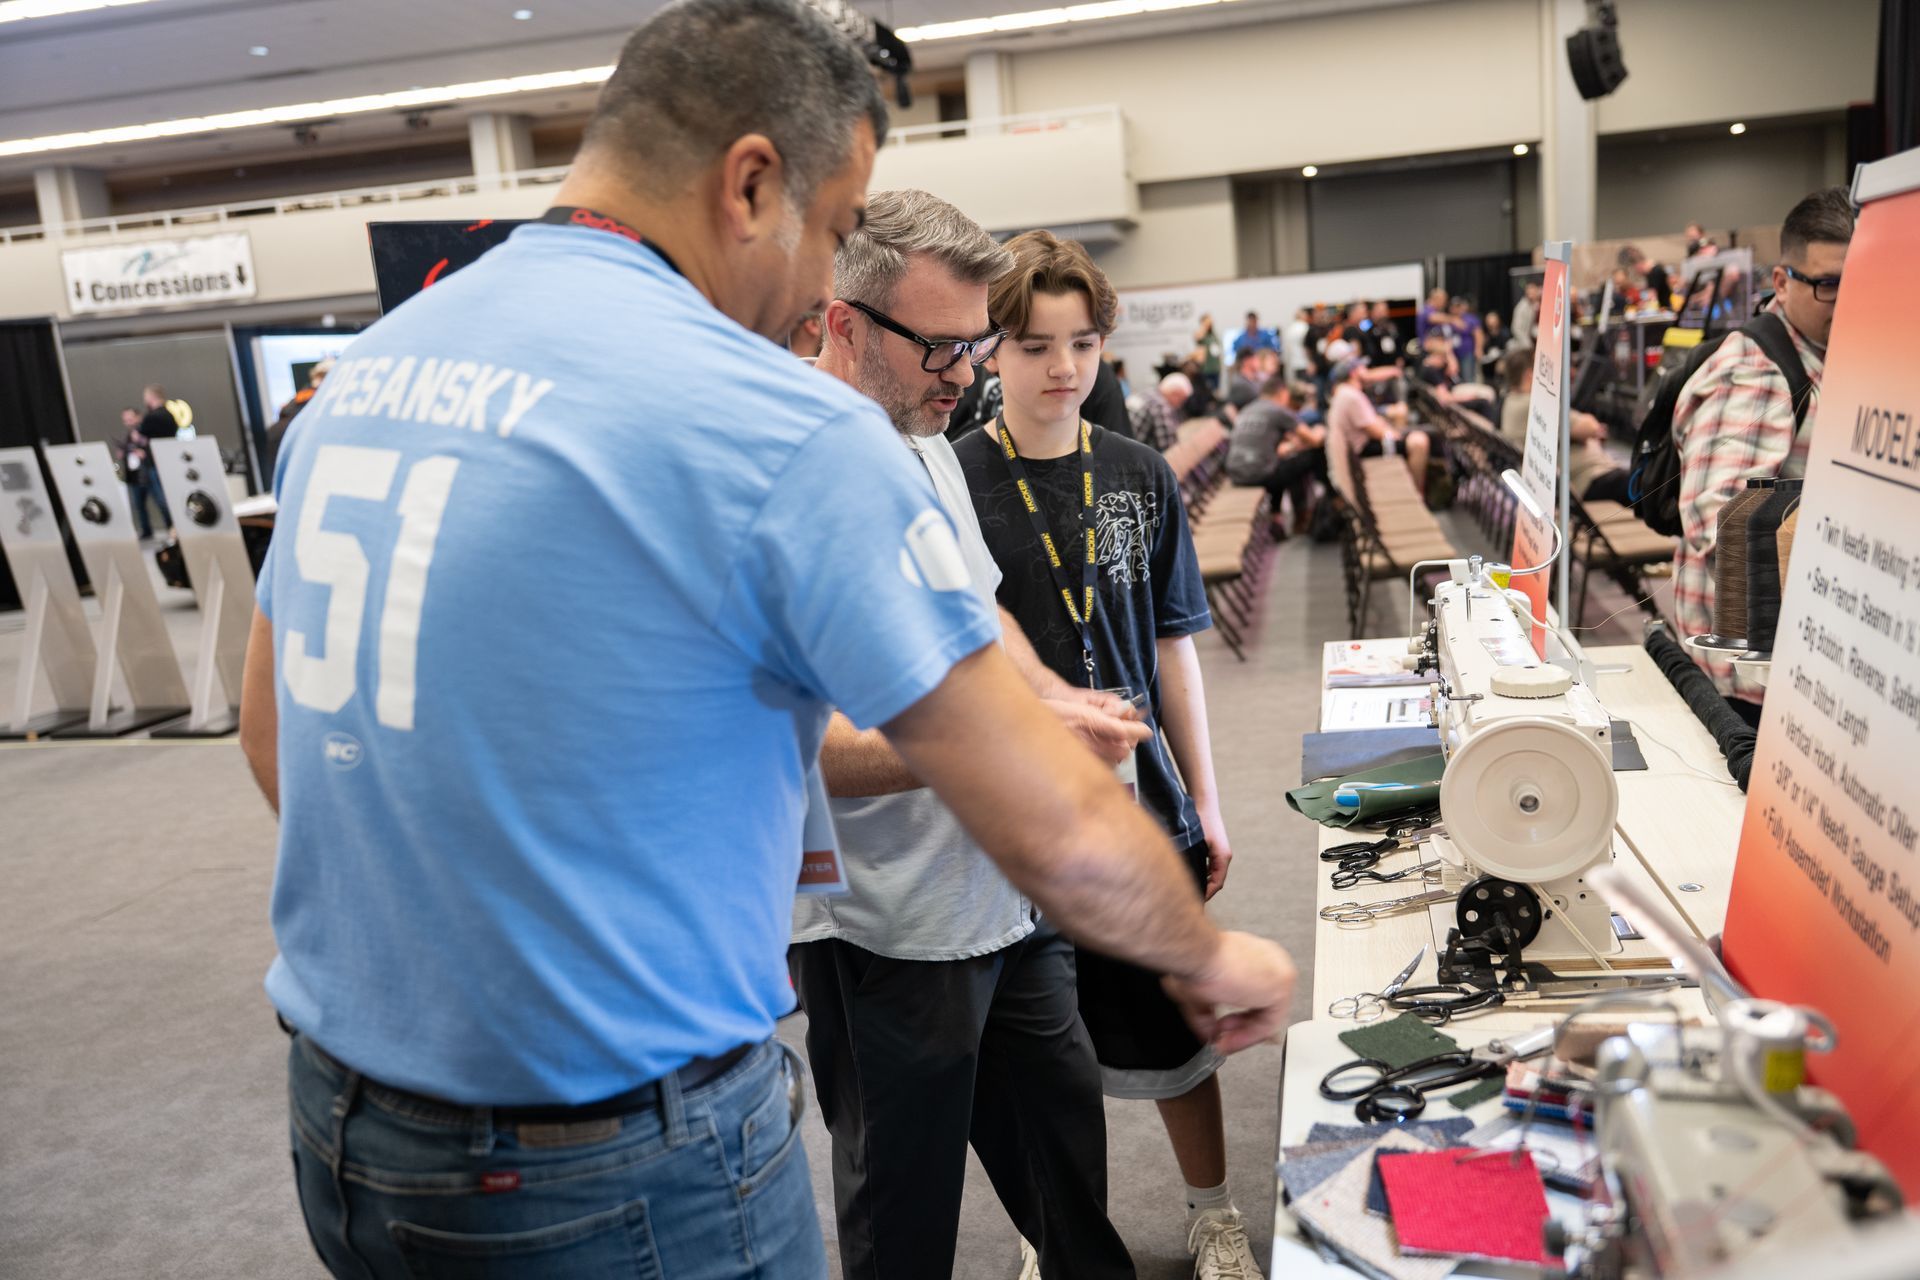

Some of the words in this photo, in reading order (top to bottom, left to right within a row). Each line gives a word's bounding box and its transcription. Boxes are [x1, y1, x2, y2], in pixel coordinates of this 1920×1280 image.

[91, 273, 231, 302] Concessions
[319, 356, 555, 438] PESANSKY
[1041, 532, 1061, 567] KICKER
[1086, 528, 1097, 564] KICKER
[1822, 516, 1841, 548] Twin
[1841, 525, 1870, 563] Needle
[1870, 538, 1910, 590] Walking
[282, 444, 461, 731] 51
[1812, 567, 1830, 598] Sew
[1829, 576, 1859, 617] French
[1859, 593, 1893, 638] Seams
[1803, 616, 1817, 652] Big
[1813, 680, 1837, 720] Stitch
[1837, 699, 1871, 746] Length
[1785, 712, 1814, 757] Vertical
[1838, 761, 1887, 827] Automatic
[1887, 805, 1920, 852] Oiler
[1790, 782, 1801, 803] or
[1818, 802, 1849, 856] Needle
[1850, 835, 1887, 893] Gauge
[1767, 806, 1786, 850] Fully
[1784, 828, 1832, 898] Assembled
[1830, 876, 1893, 966] Workstation
